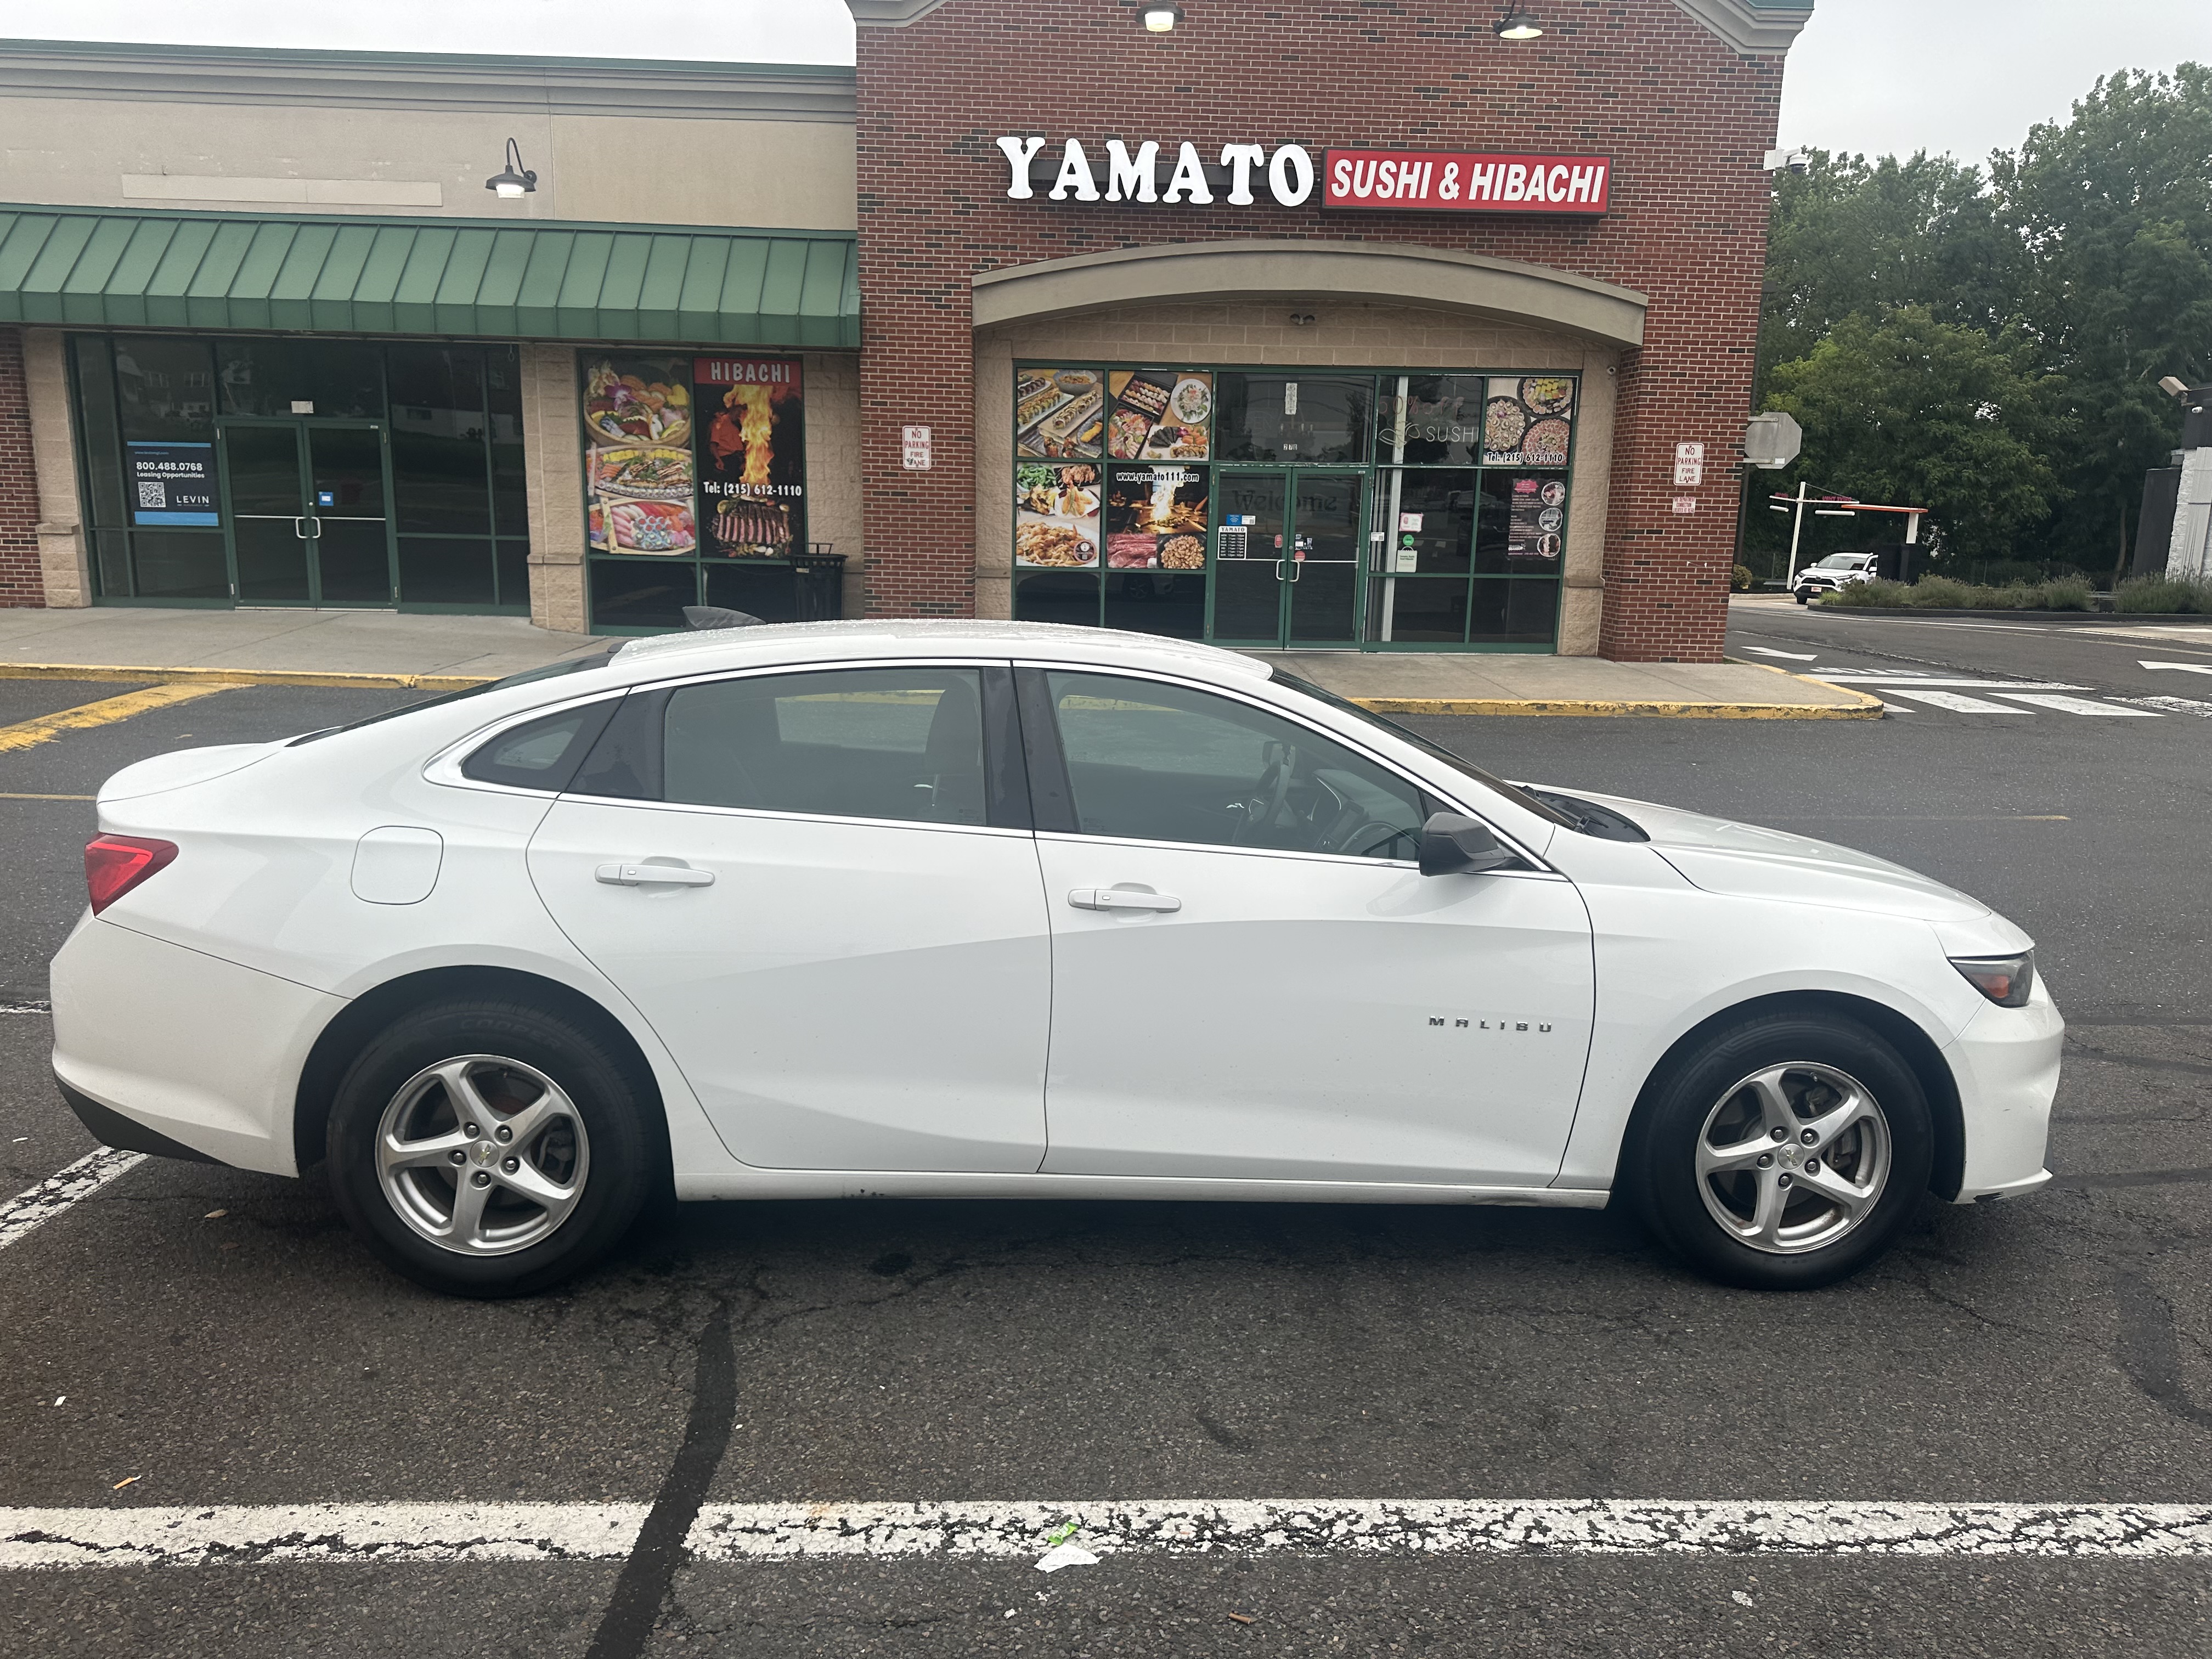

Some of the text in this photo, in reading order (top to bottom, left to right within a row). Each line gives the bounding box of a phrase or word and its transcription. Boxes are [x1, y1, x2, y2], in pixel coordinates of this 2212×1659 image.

[996, 136, 1314, 207] YAMATO
[1331, 159, 1605, 203] SUSHI & HIBACHI
[711, 362, 790, 383] HIBACHI
[1426, 426, 1479, 442] SUSHI
[905, 441, 929, 449] PARKING
[1685, 447, 1695, 455] NO
[1488, 452, 1562, 464] Tel: (215) 612-1110
[137, 461, 203, 471] 800.488.0768
[1117, 472, 1199, 484] www.yamato111.com
[703, 481, 802, 496] Tel: (215) 612-1110
[176, 495, 210, 504] LEVIN
[1809, 667, 1930, 676] STOP
[1429, 1015, 1552, 1032] MALIBU
